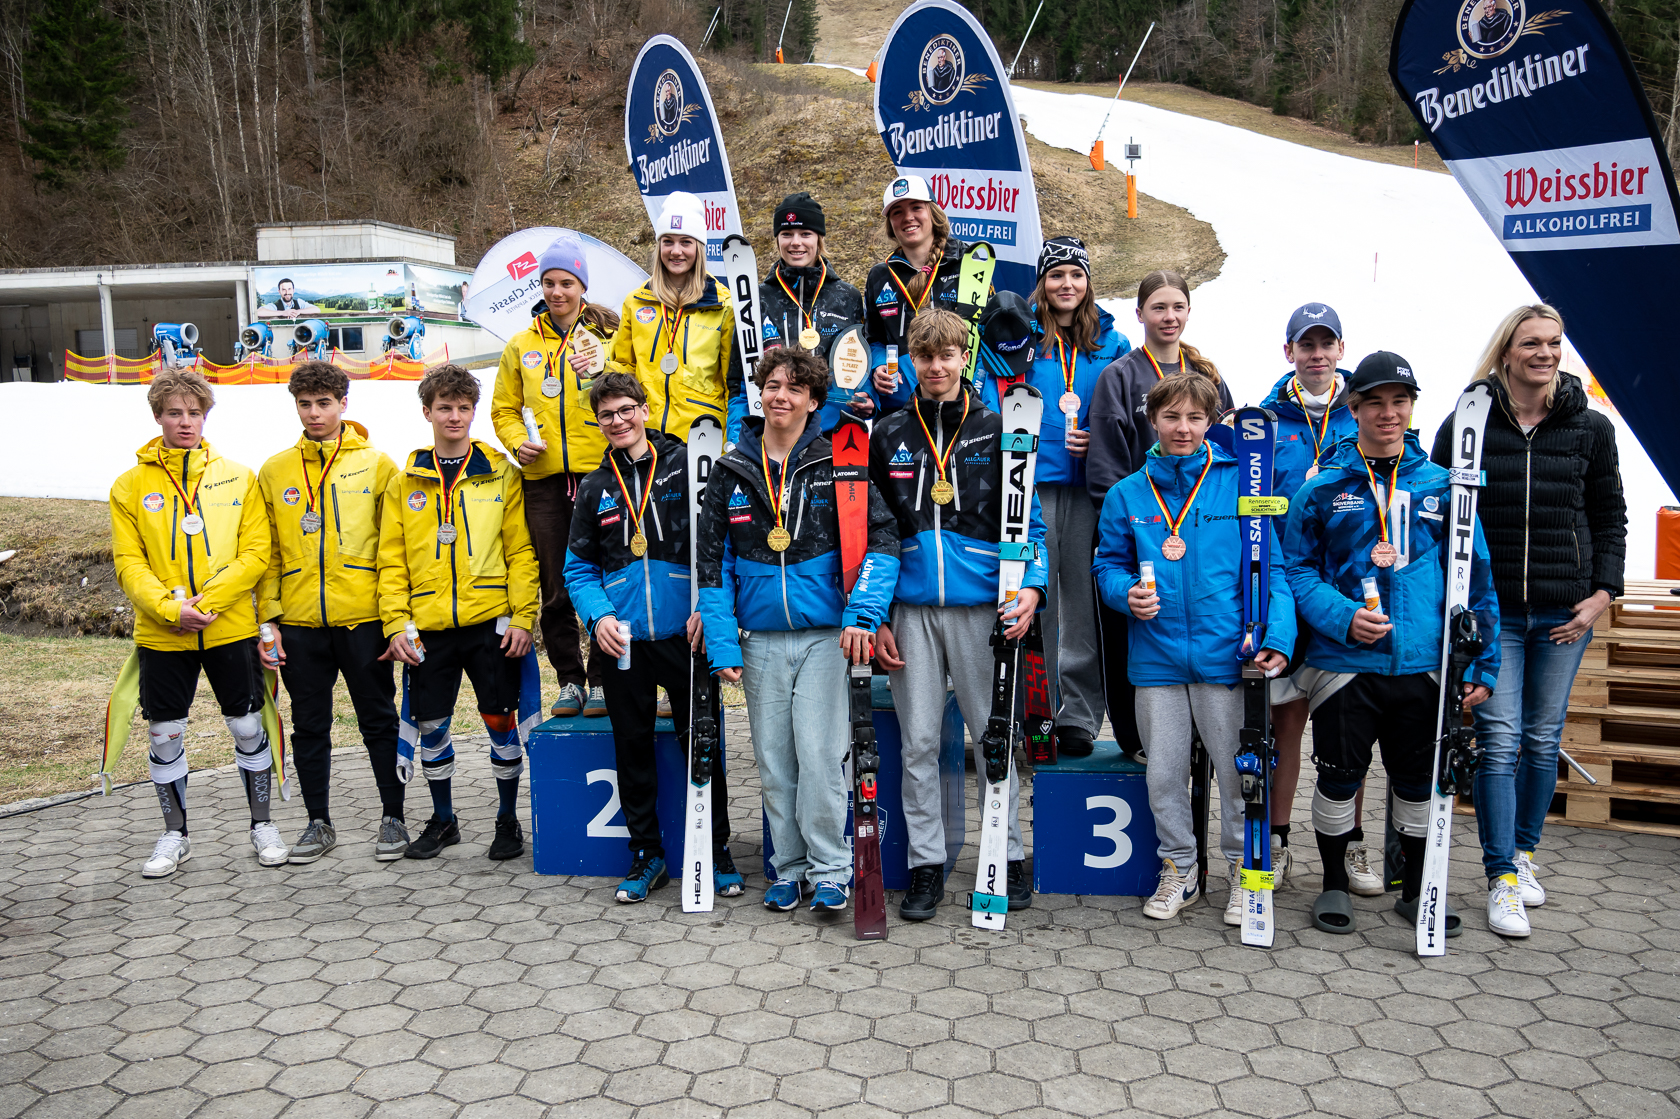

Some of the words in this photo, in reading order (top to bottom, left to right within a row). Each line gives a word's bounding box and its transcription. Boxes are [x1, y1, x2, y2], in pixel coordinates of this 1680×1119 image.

[1415, 43, 1590, 133] Benediktiner
[889, 110, 1001, 165] Benediktiner
[637, 137, 710, 194] Benediktiner
[1503, 162, 1650, 209] Weissbier
[930, 173, 1020, 214] Weissbier
[949, 221, 1012, 240] KOHOLFREI
[1512, 211, 1640, 234] ALKOHOLFREI
[1250, 453, 1262, 543] SAMON
[156, 785, 171, 814] SOCKS
[255, 773, 268, 803] SOCKS
[586, 769, 631, 838] 2
[1084, 795, 1133, 869] 3
[694, 860, 702, 905] HEAD
[985, 864, 996, 920] HAD
[1428, 886, 1438, 948] HEAD
